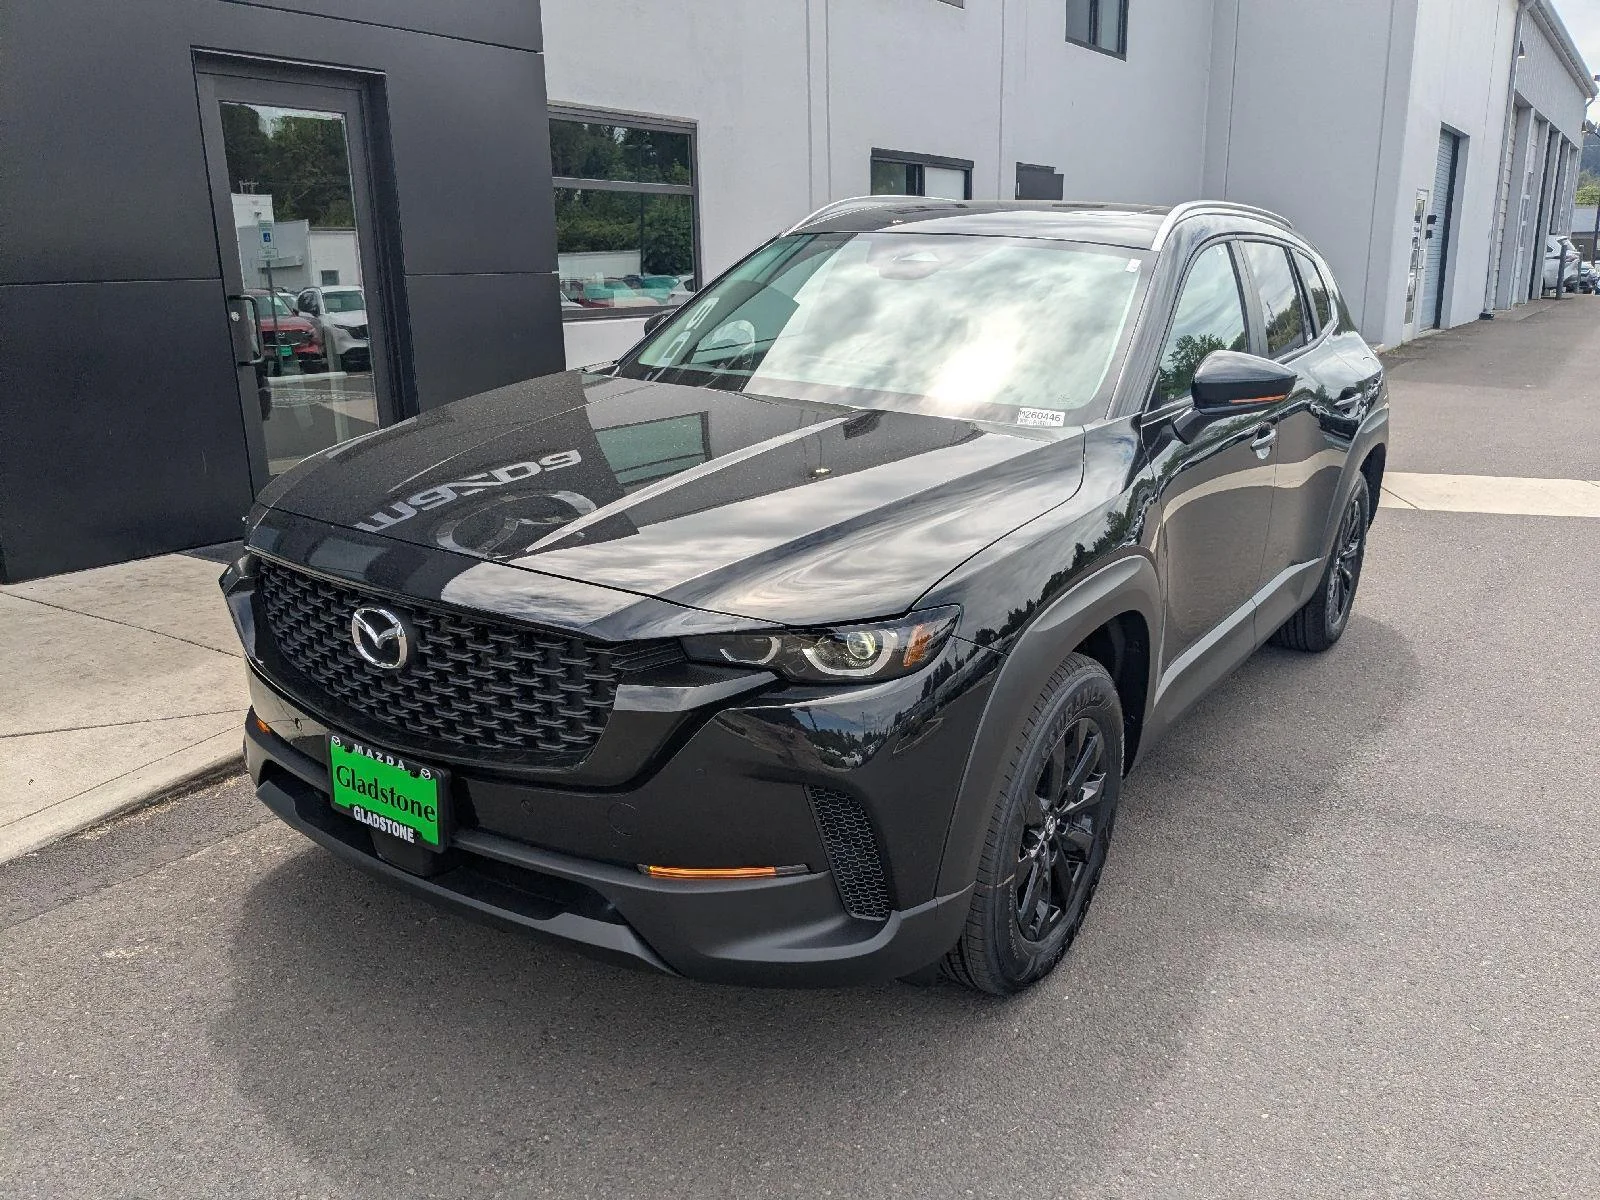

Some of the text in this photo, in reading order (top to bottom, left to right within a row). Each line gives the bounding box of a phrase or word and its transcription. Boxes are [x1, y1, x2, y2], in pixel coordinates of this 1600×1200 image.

[354, 743, 406, 771] MAZDA
[336, 765, 436, 823] Gladstone
[353, 805, 415, 844] GLADSTONE
